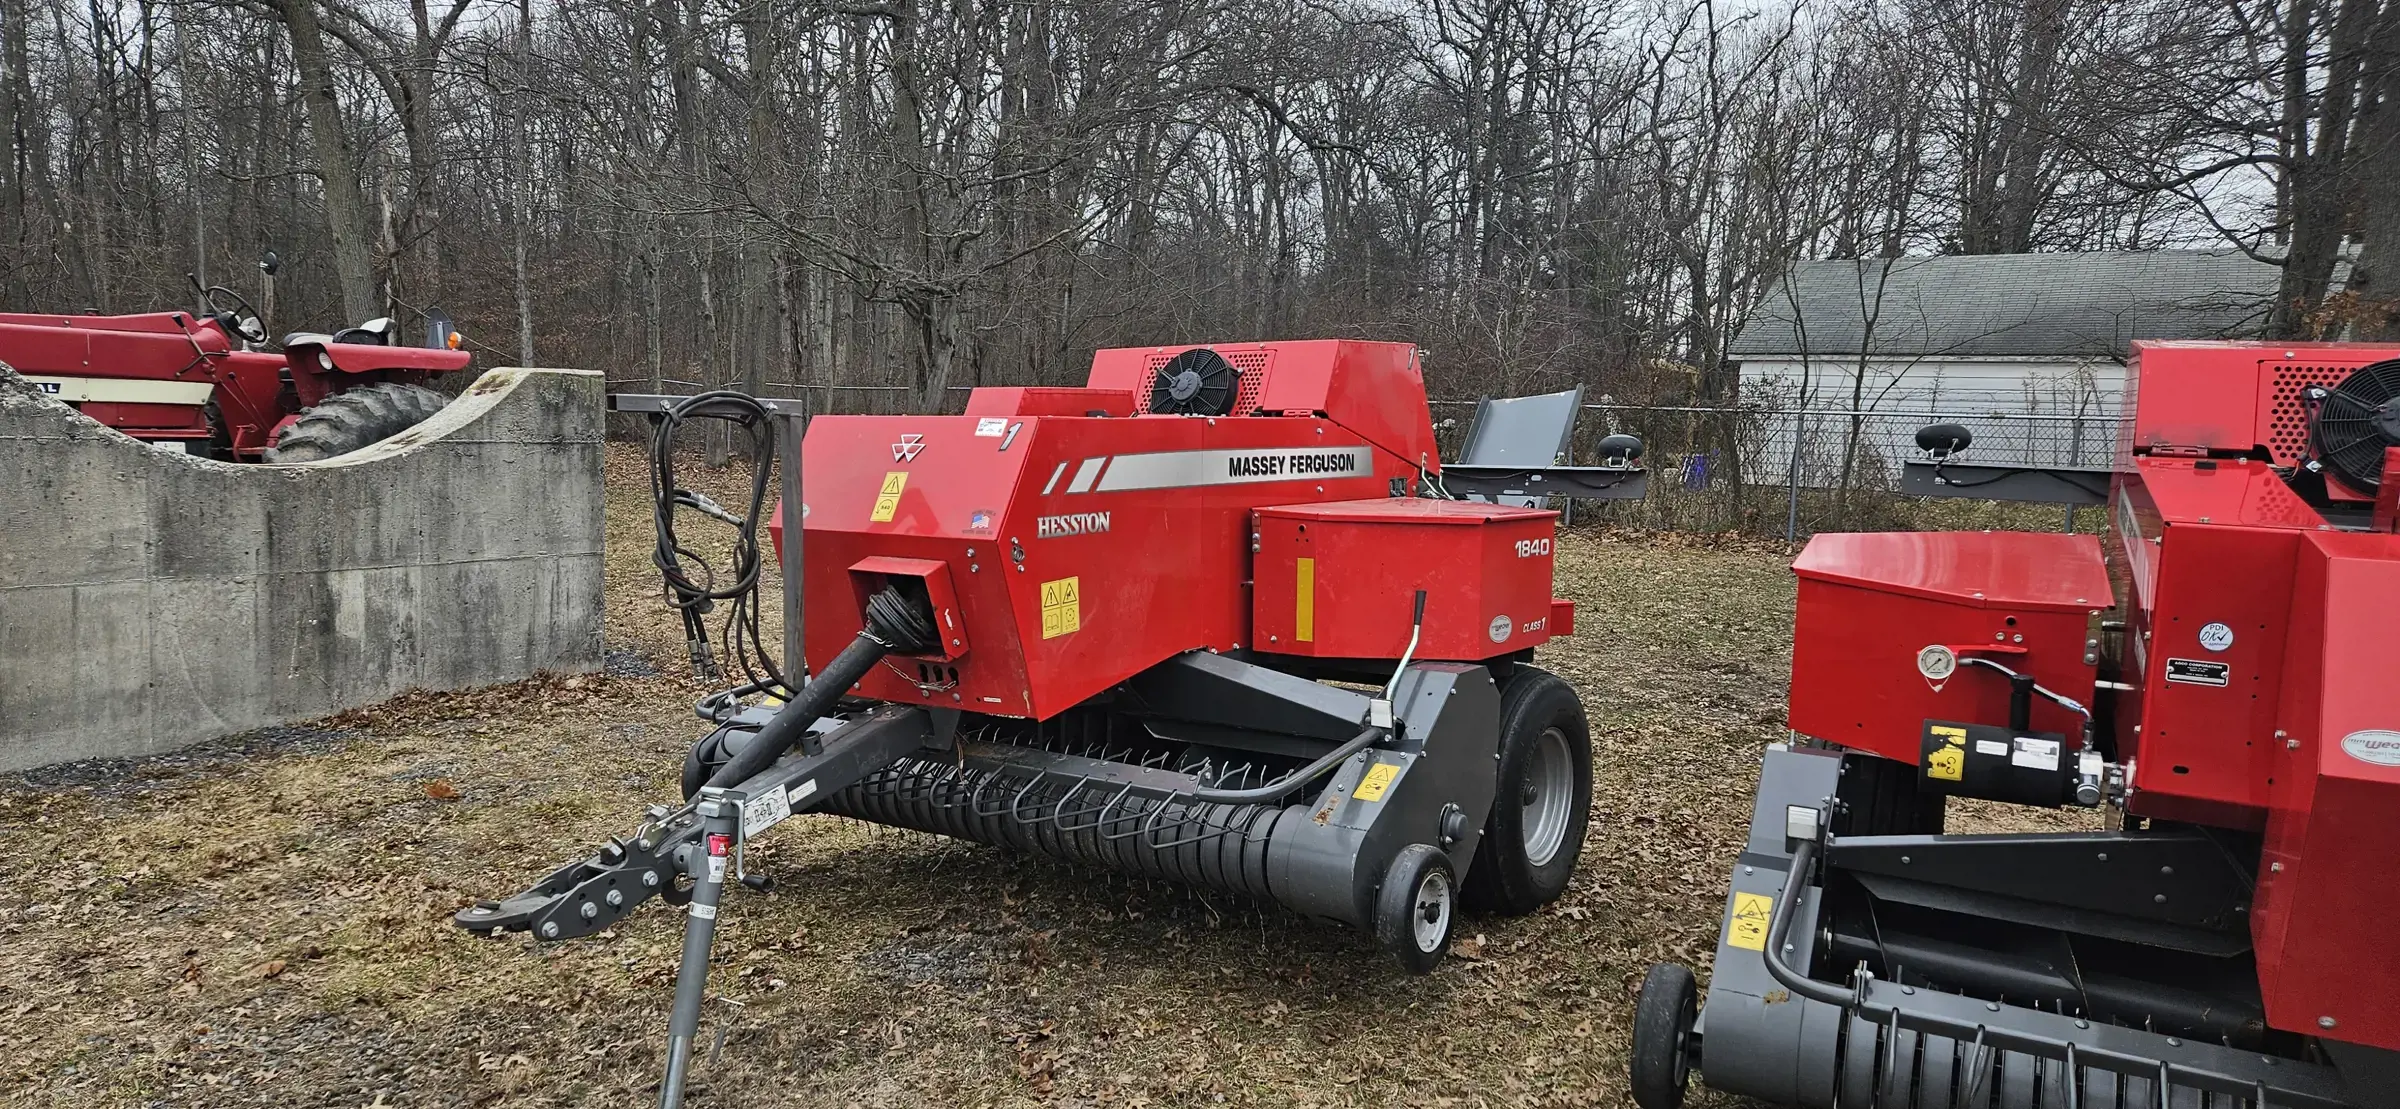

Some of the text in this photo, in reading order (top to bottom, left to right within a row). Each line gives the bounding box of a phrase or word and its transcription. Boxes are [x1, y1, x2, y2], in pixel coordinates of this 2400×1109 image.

[998, 421, 1023, 452] 1
[1229, 454, 1355, 477] MASSEY FERGUSON
[1037, 511, 1111, 539] HESSTON
[1515, 538, 1550, 558] 1840
[1522, 620, 1541, 633] CLASS
[1541, 616, 1546, 630] 1
